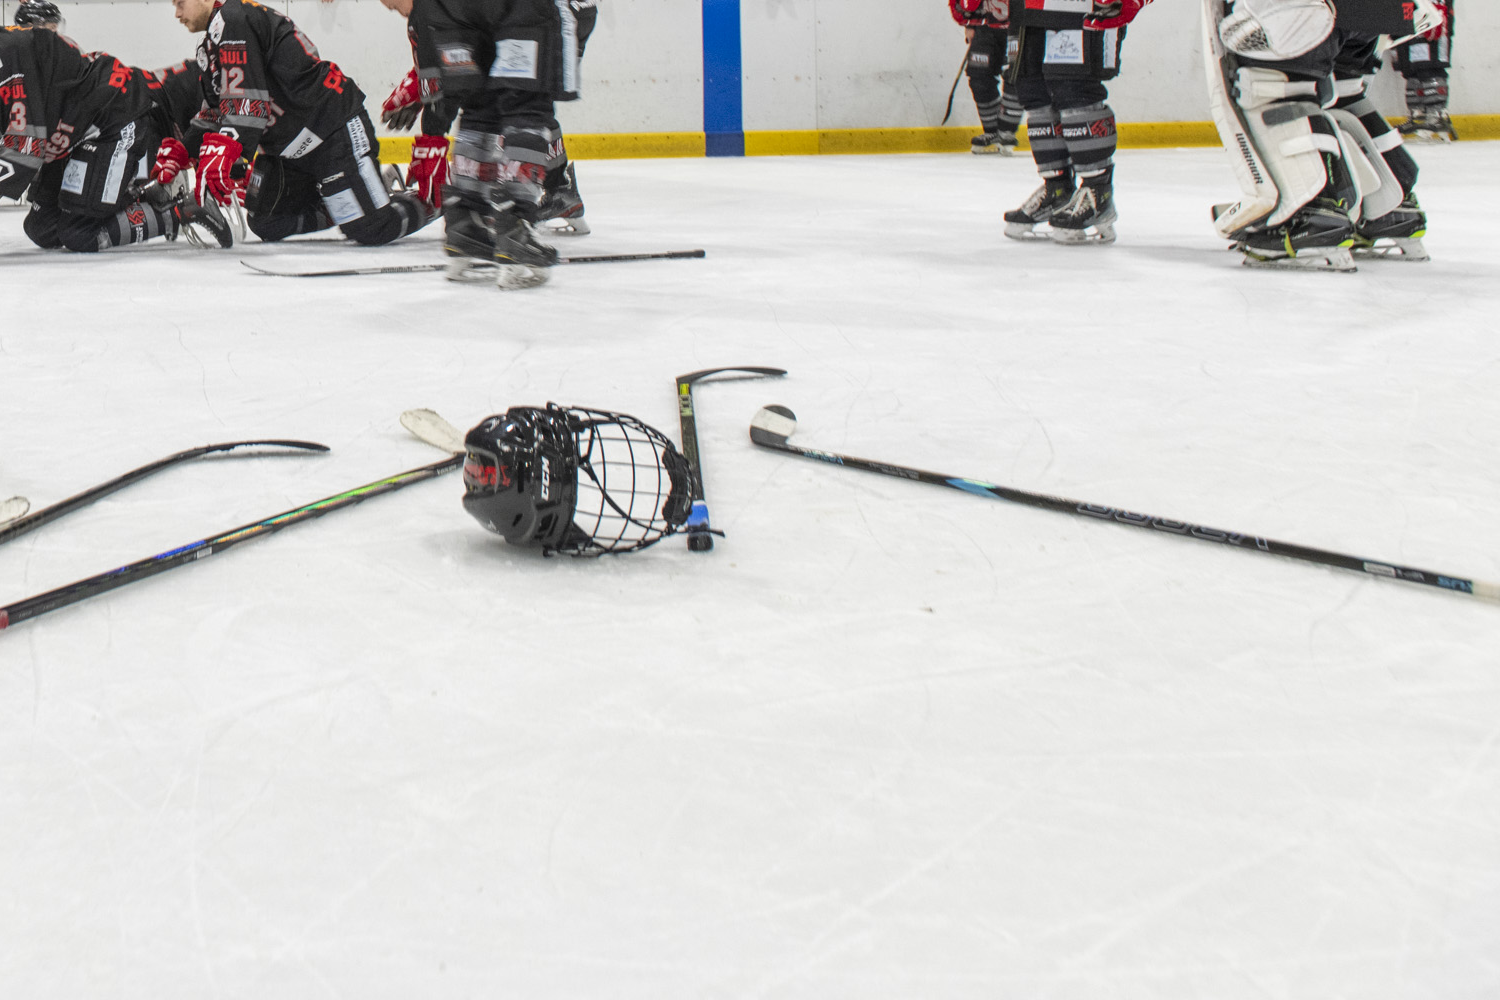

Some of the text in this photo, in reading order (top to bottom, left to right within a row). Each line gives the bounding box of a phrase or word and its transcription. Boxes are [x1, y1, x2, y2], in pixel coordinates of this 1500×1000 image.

[198, 144, 227, 156] CM
[1235, 132, 1263, 185] WARRIOR
[541, 455, 550, 500] CCM
